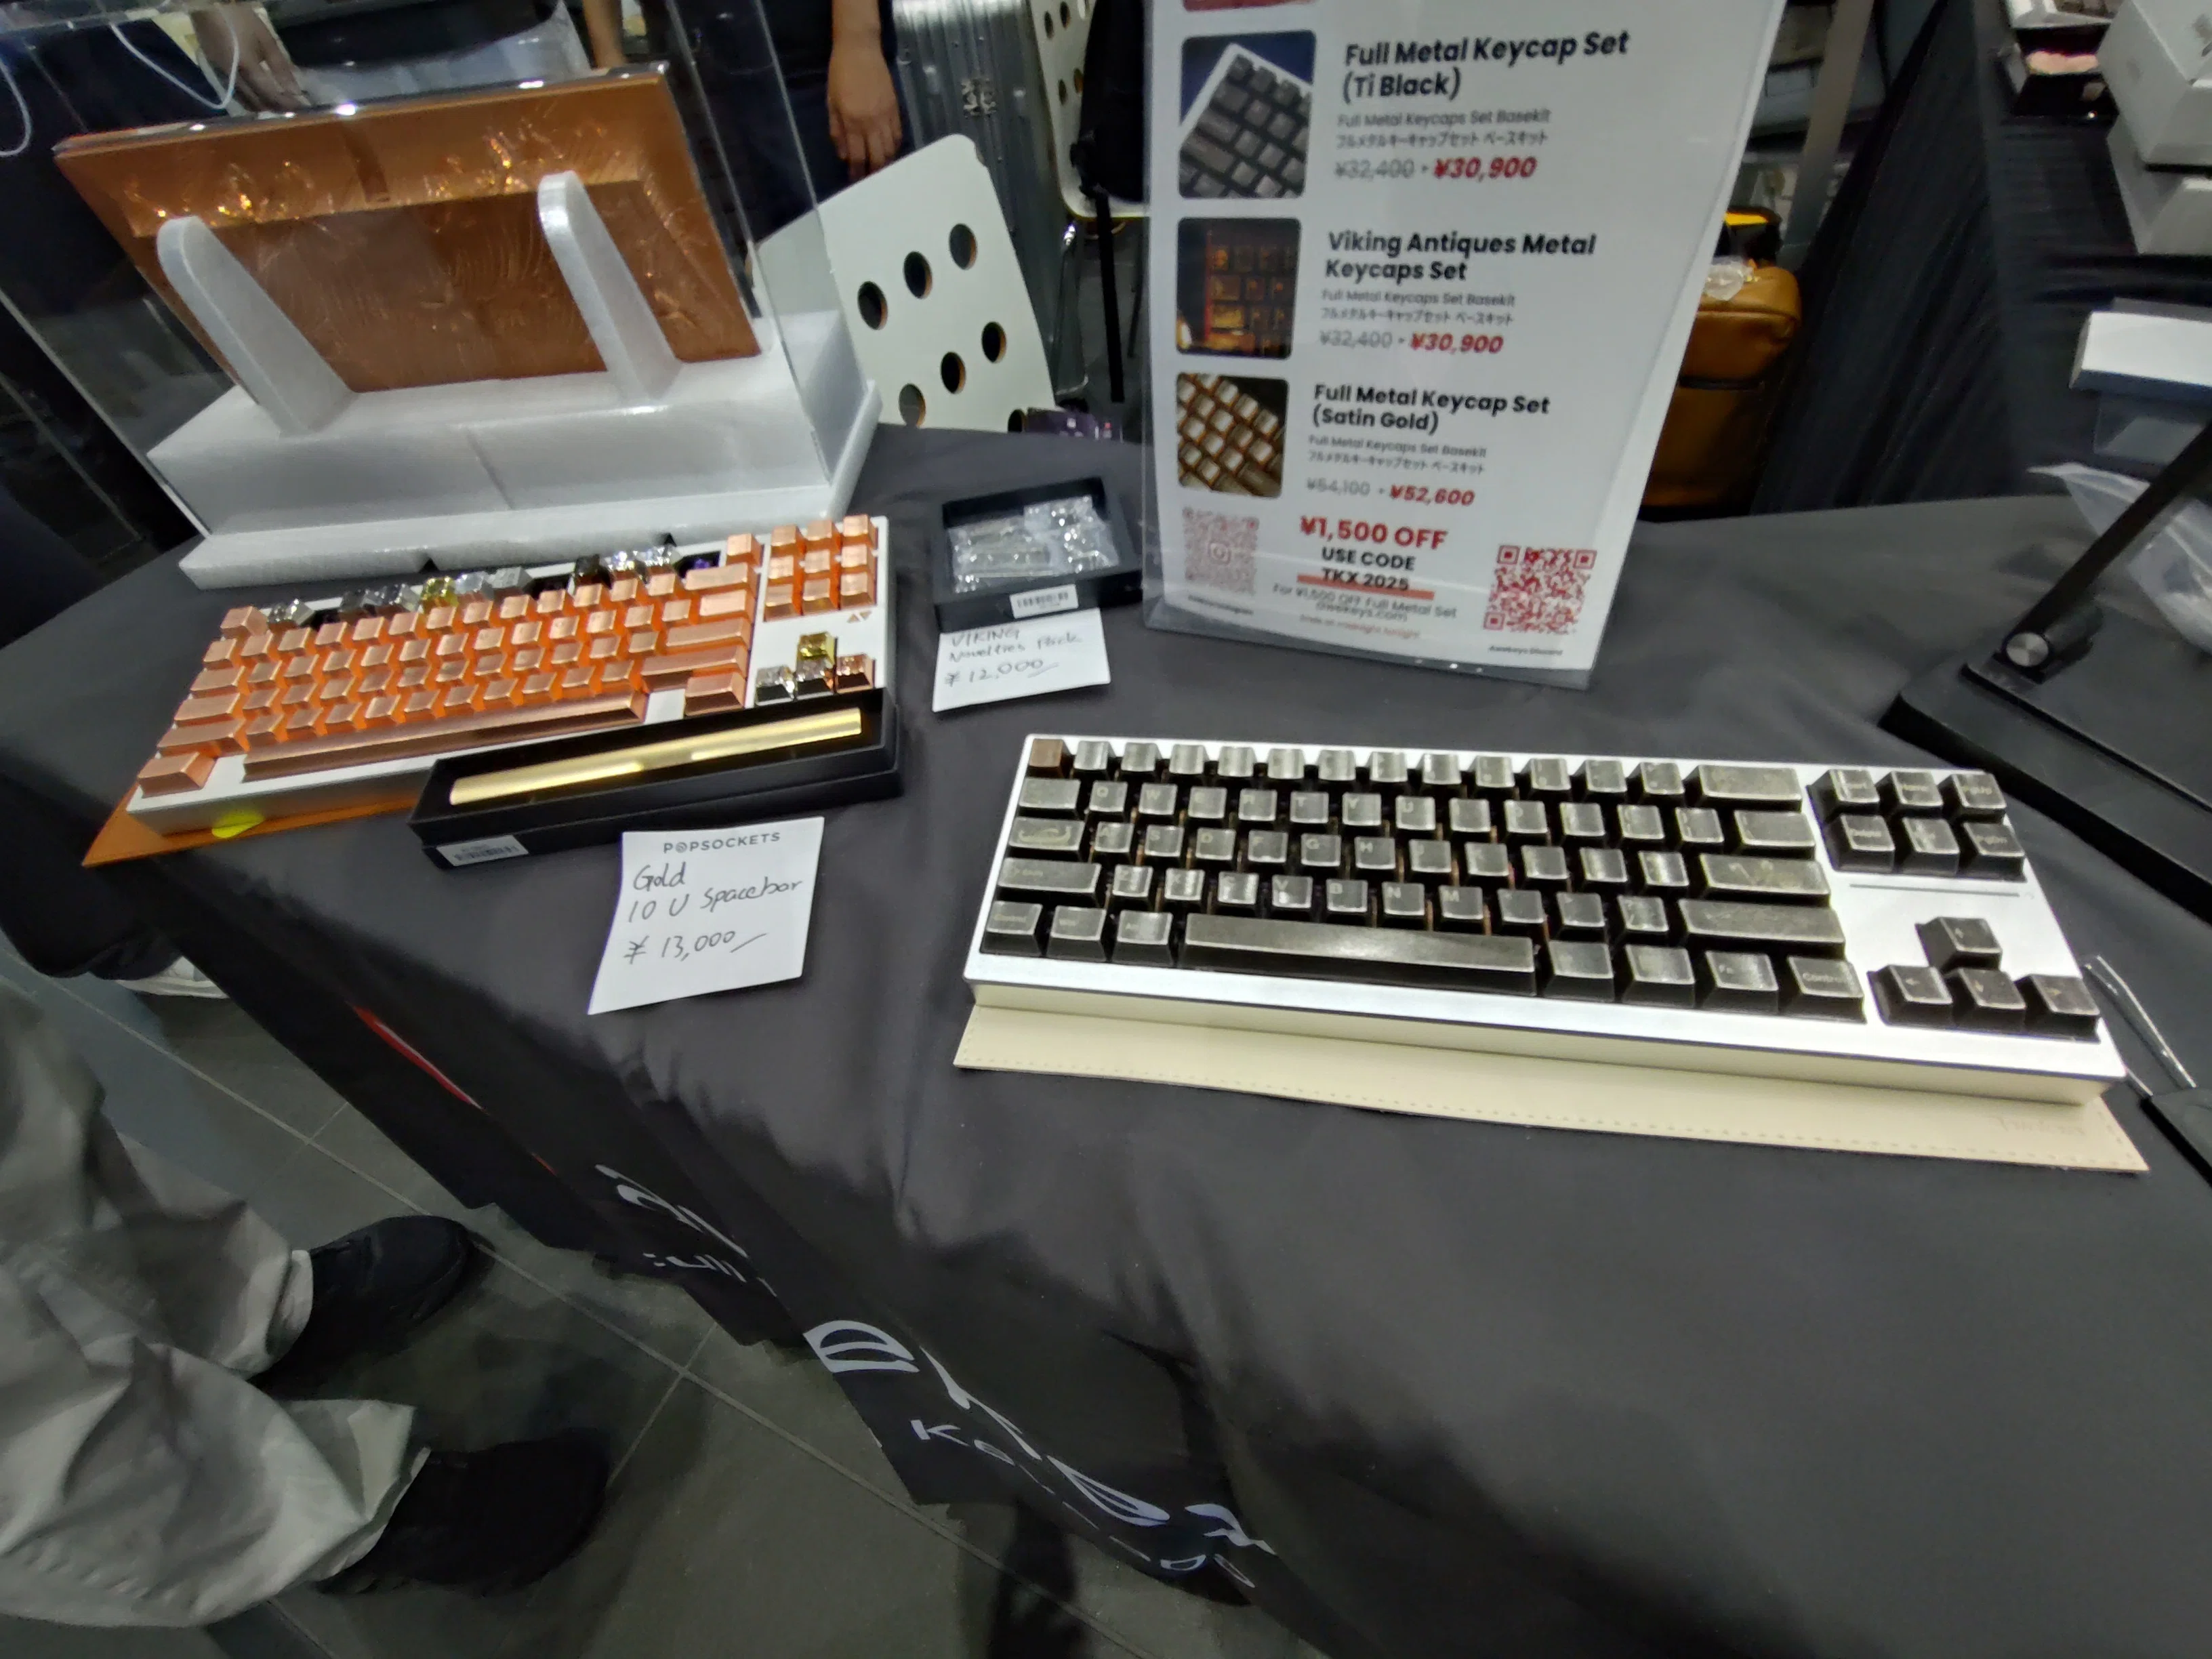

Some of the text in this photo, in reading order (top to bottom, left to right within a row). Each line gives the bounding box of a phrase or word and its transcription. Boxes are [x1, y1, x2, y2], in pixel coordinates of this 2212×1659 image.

[1345, 29, 1630, 68] Full Metal Keycap Set
[1343, 67, 1461, 104] (Ti Black)
[1434, 157, 1538, 182] ¥30,900
[1328, 230, 1597, 259] Viking Antiques Metal
[1326, 259, 1468, 285] Keycaps Set
[1410, 331, 1504, 354] ¥30,900
[1315, 384, 1551, 417] Full Metal Keycap Set
[1313, 404, 1439, 436] (Satin Gold)
[1389, 483, 1475, 506] ¥52,600
[1300, 515, 1449, 550] ¥1,500 OFF
[1322, 546, 1416, 571] USE CODE
[1322, 567, 1410, 591] TKX 2025
[951, 627, 1019, 647] VIKING
[663, 832, 781, 854] POPSOCKETS
[633, 861, 687, 892] Gold
[628, 899, 657, 923] 10
